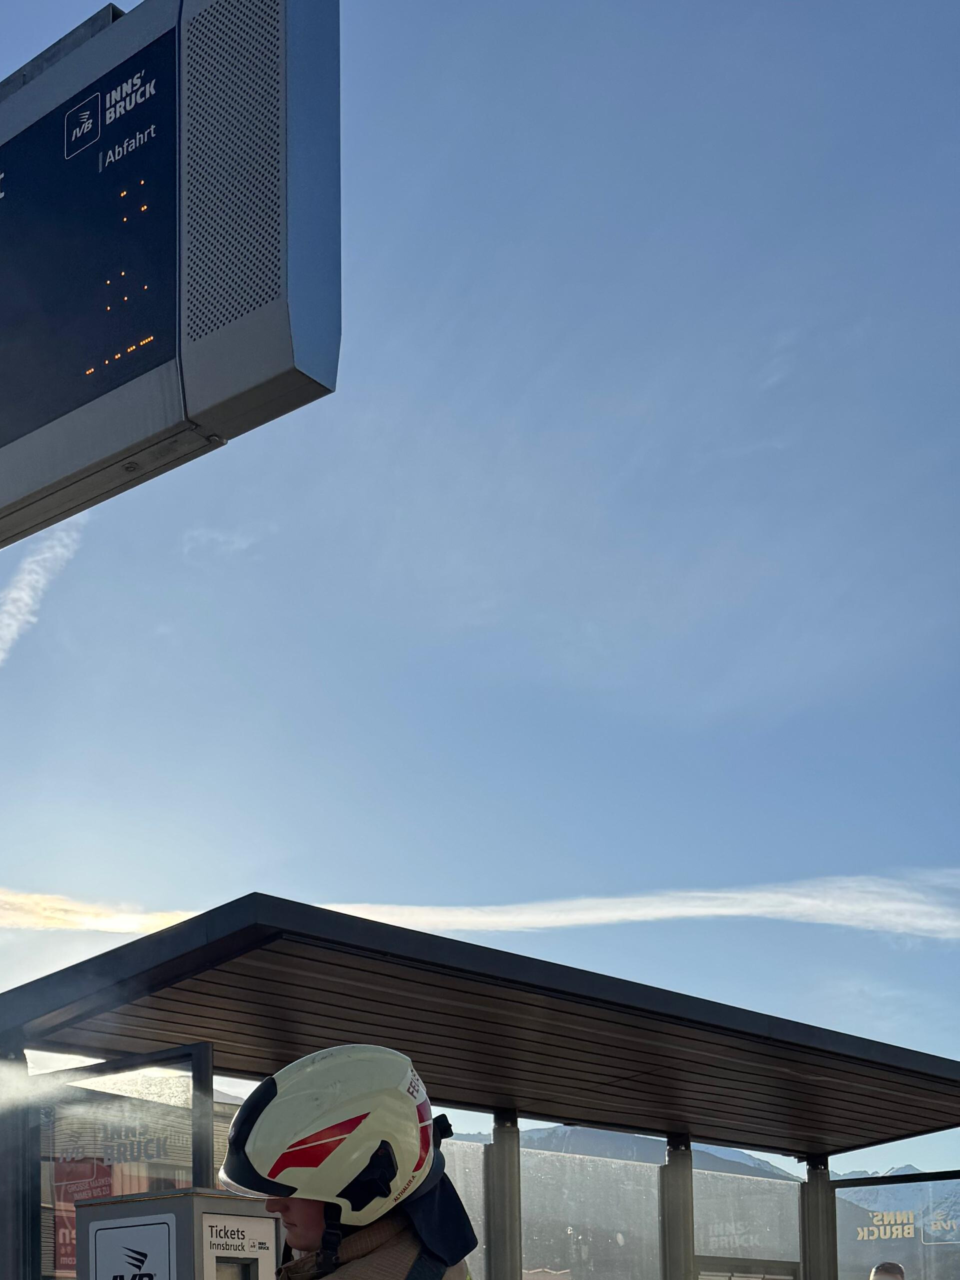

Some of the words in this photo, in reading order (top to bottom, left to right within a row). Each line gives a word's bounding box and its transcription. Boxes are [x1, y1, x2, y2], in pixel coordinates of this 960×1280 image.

[106, 79, 156, 125] BRUCK
[71, 119, 93, 141] IVB
[105, 124, 156, 167] Abfahrt
[208, 1225, 246, 1241] Tickets
[209, 1240, 246, 1252] Innsbruck
